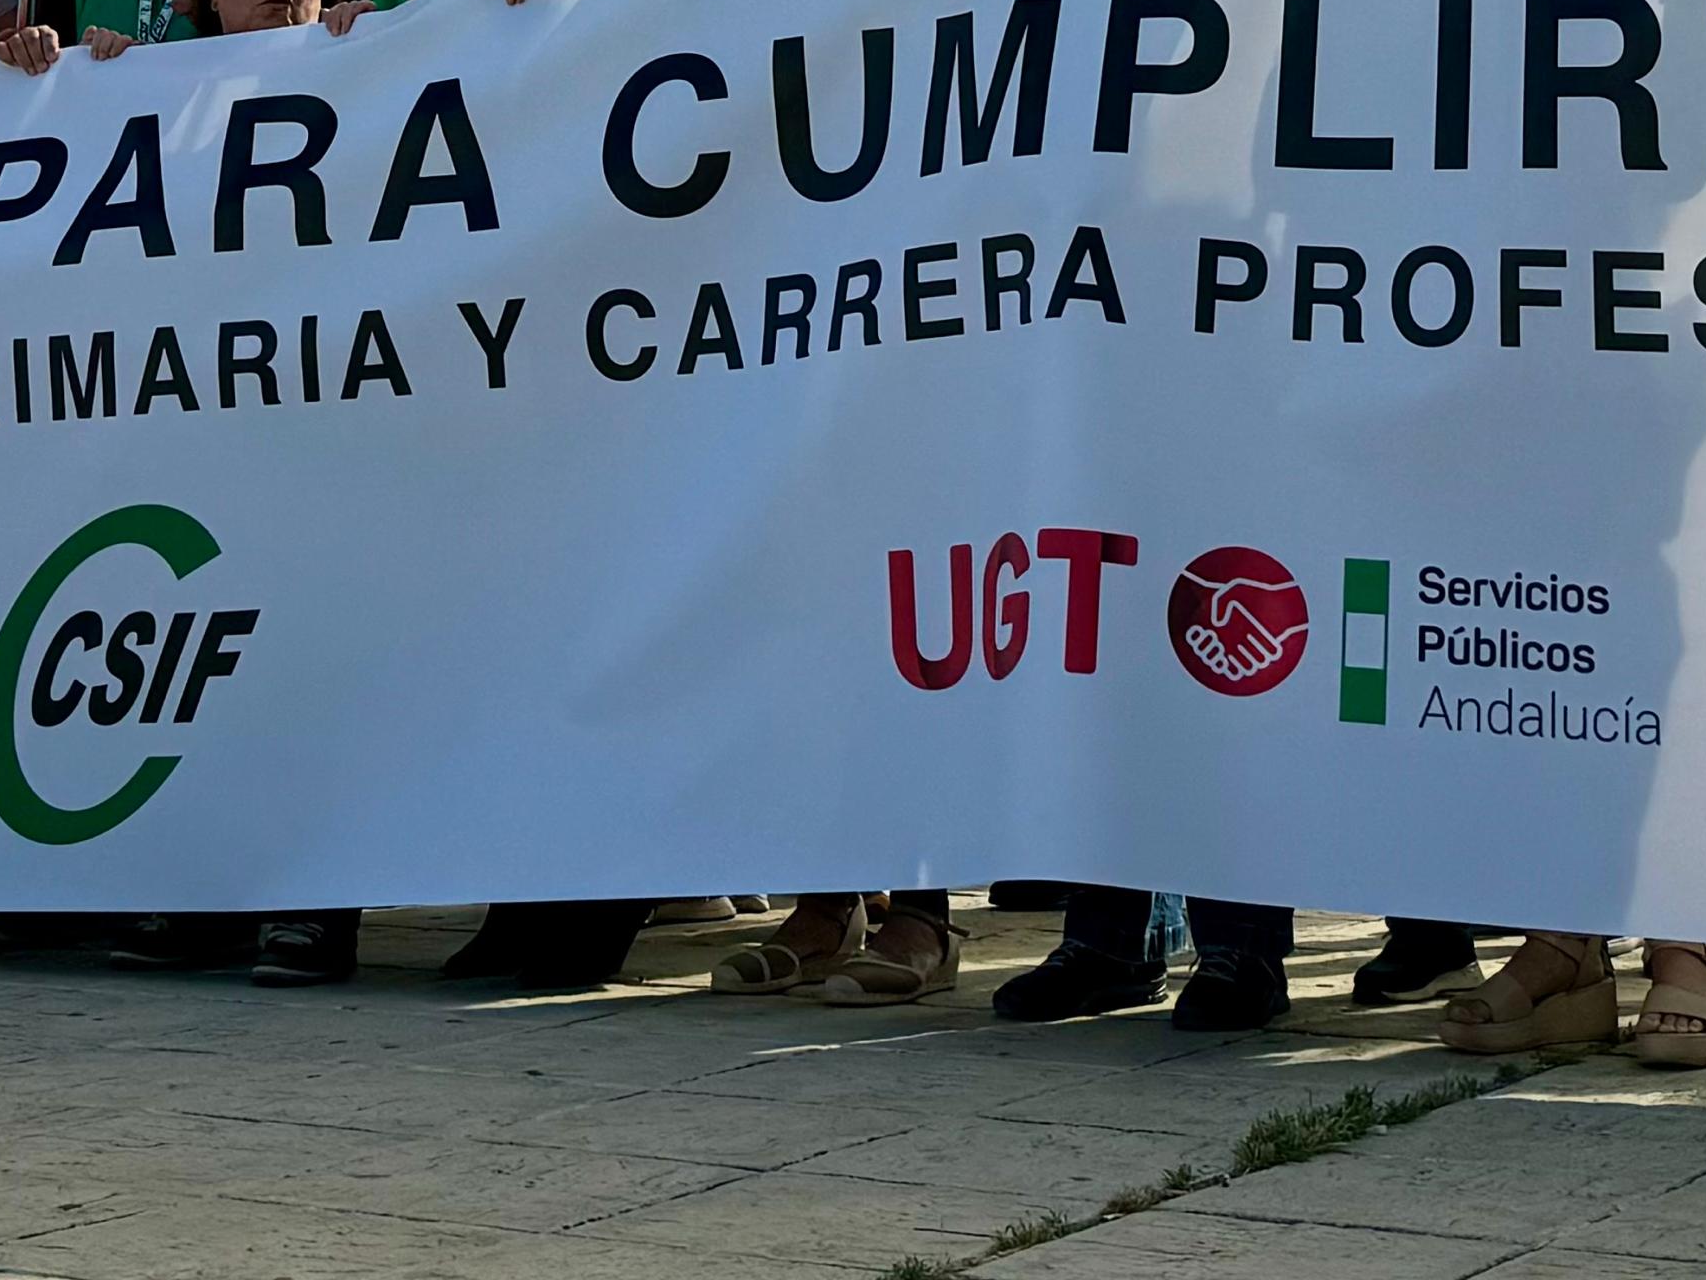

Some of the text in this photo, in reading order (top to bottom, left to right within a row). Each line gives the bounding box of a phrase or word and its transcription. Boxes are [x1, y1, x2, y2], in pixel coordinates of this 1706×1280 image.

[456, 297, 526, 389] Y
[585, 224, 1127, 382] CARRERA
[887, 526, 1139, 692] UGT
[1417, 564, 1612, 616] Servicios
[31, 608, 262, 728] CSIF
[1417, 623, 1598, 676] Públicos
[1418, 685, 1663, 747] Andalucía
